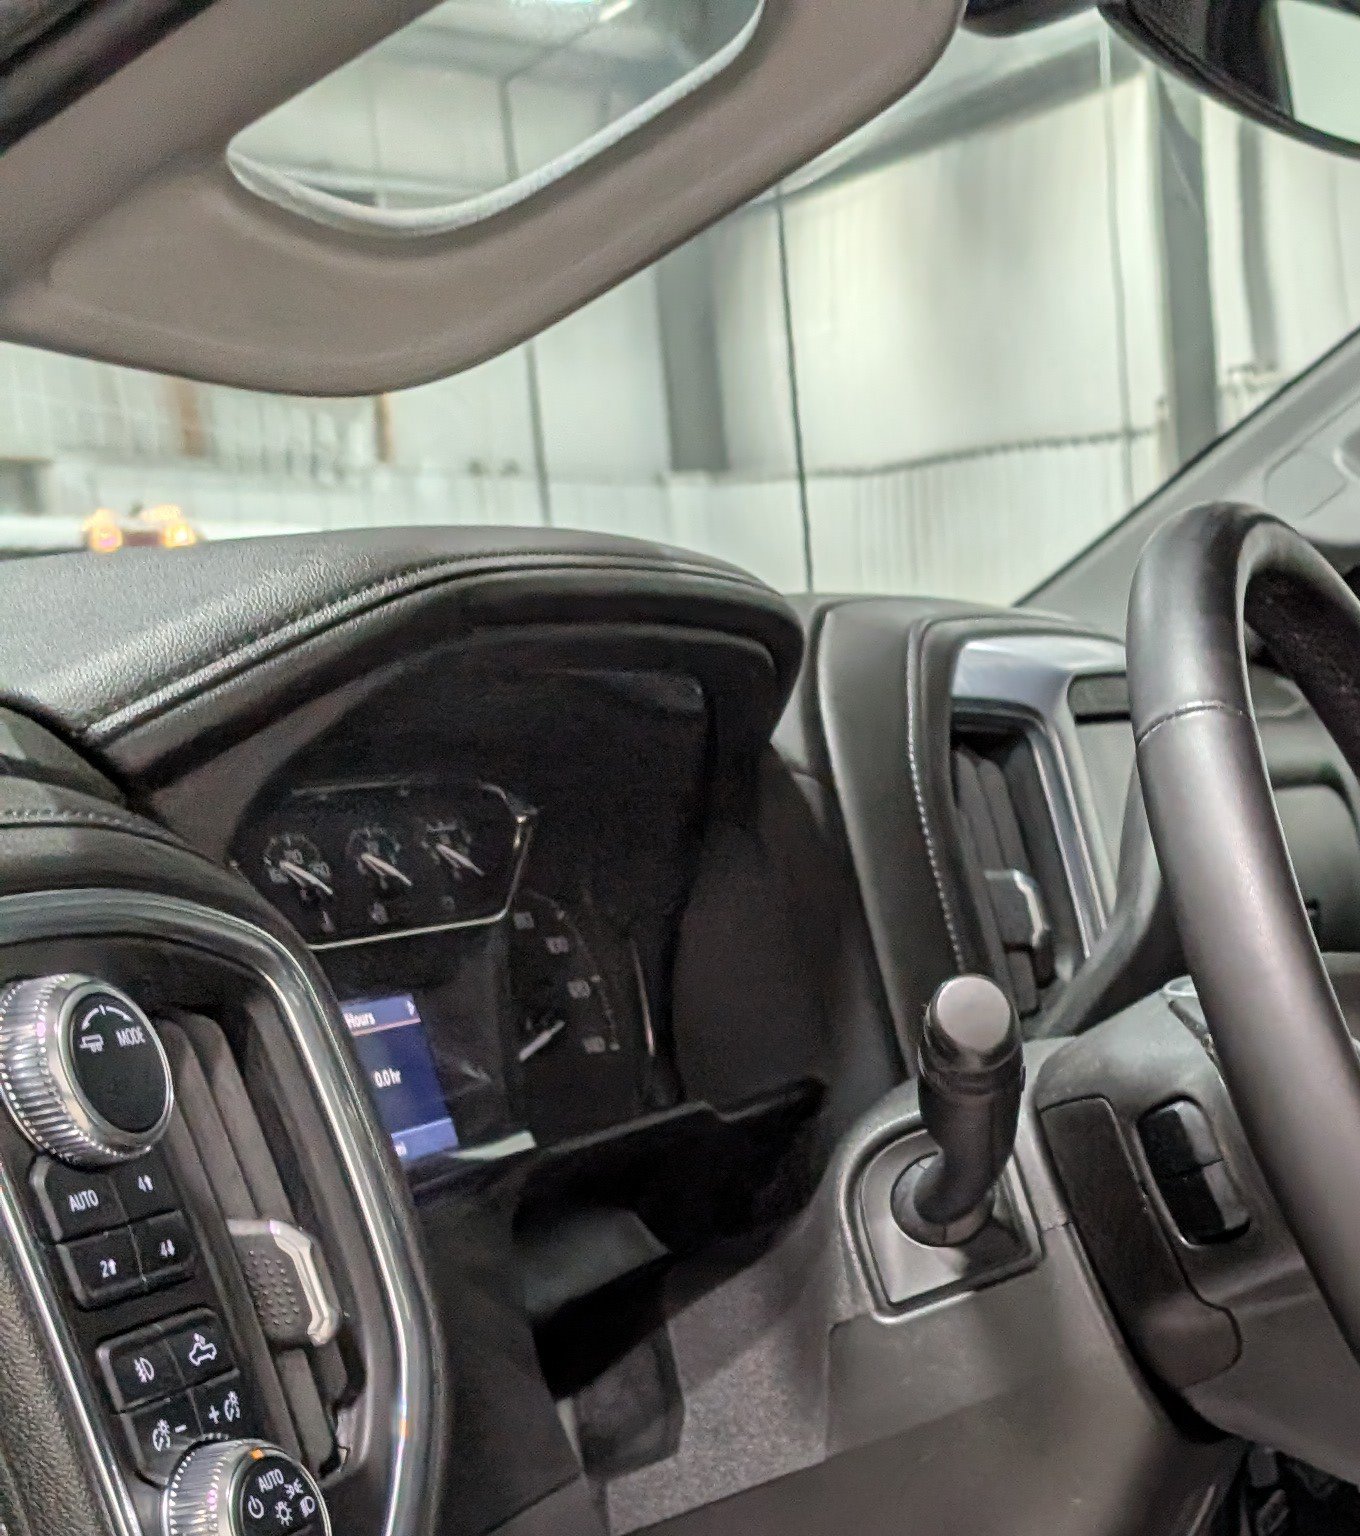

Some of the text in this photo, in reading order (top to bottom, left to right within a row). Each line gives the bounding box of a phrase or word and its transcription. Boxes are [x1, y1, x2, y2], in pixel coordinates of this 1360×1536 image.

[116, 1026, 146, 1048] MODE
[374, 1067, 401, 1088] 0.0 hr
[68, 1189, 99, 1213] AUTO
[258, 1468, 284, 1493] AUTO
